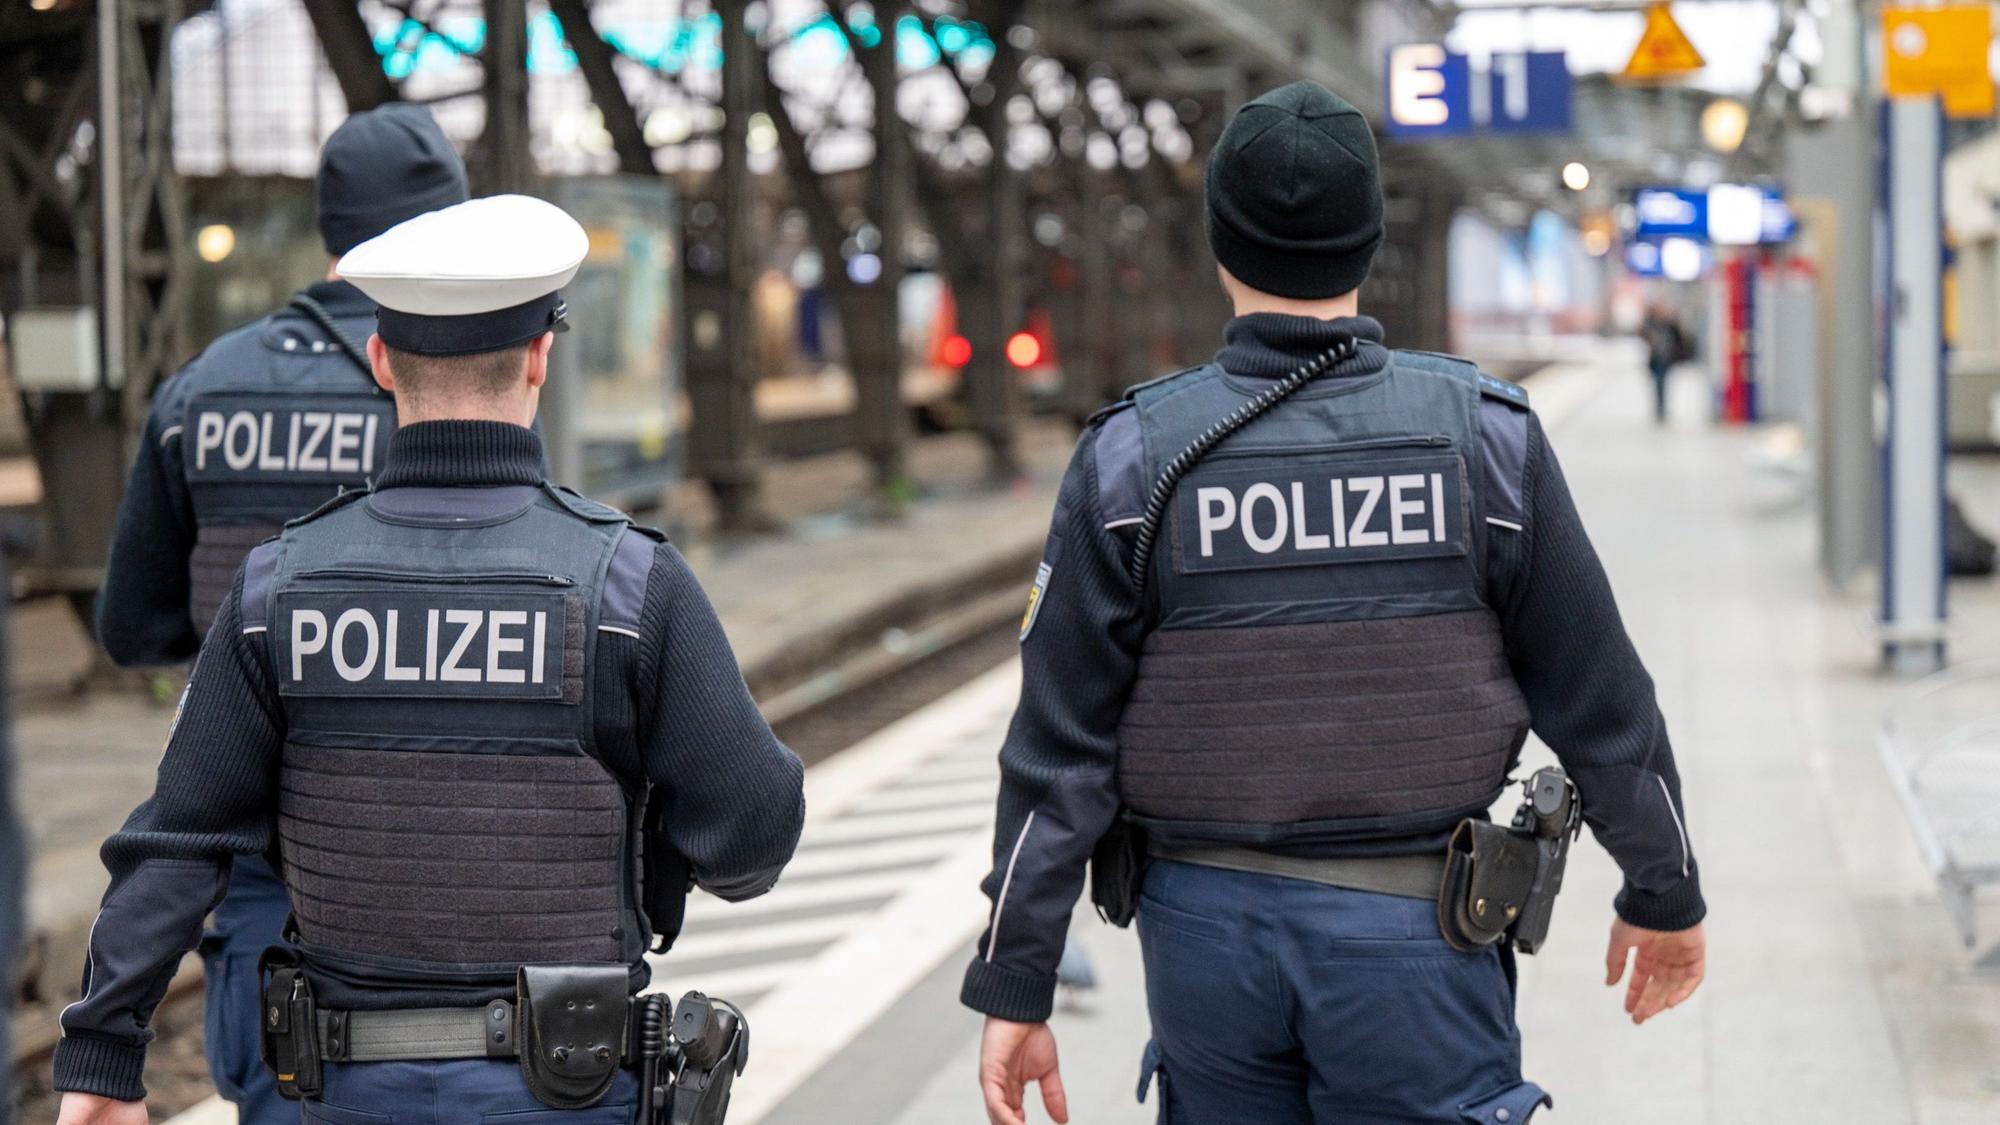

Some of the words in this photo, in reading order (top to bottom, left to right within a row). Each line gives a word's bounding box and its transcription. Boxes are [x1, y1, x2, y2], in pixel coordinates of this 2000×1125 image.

[1390, 43, 1449, 125] E
[196, 411, 378, 473] POLIZEI
[1198, 473, 1446, 557] POLIZEI
[291, 608, 547, 684] POLIZEI
